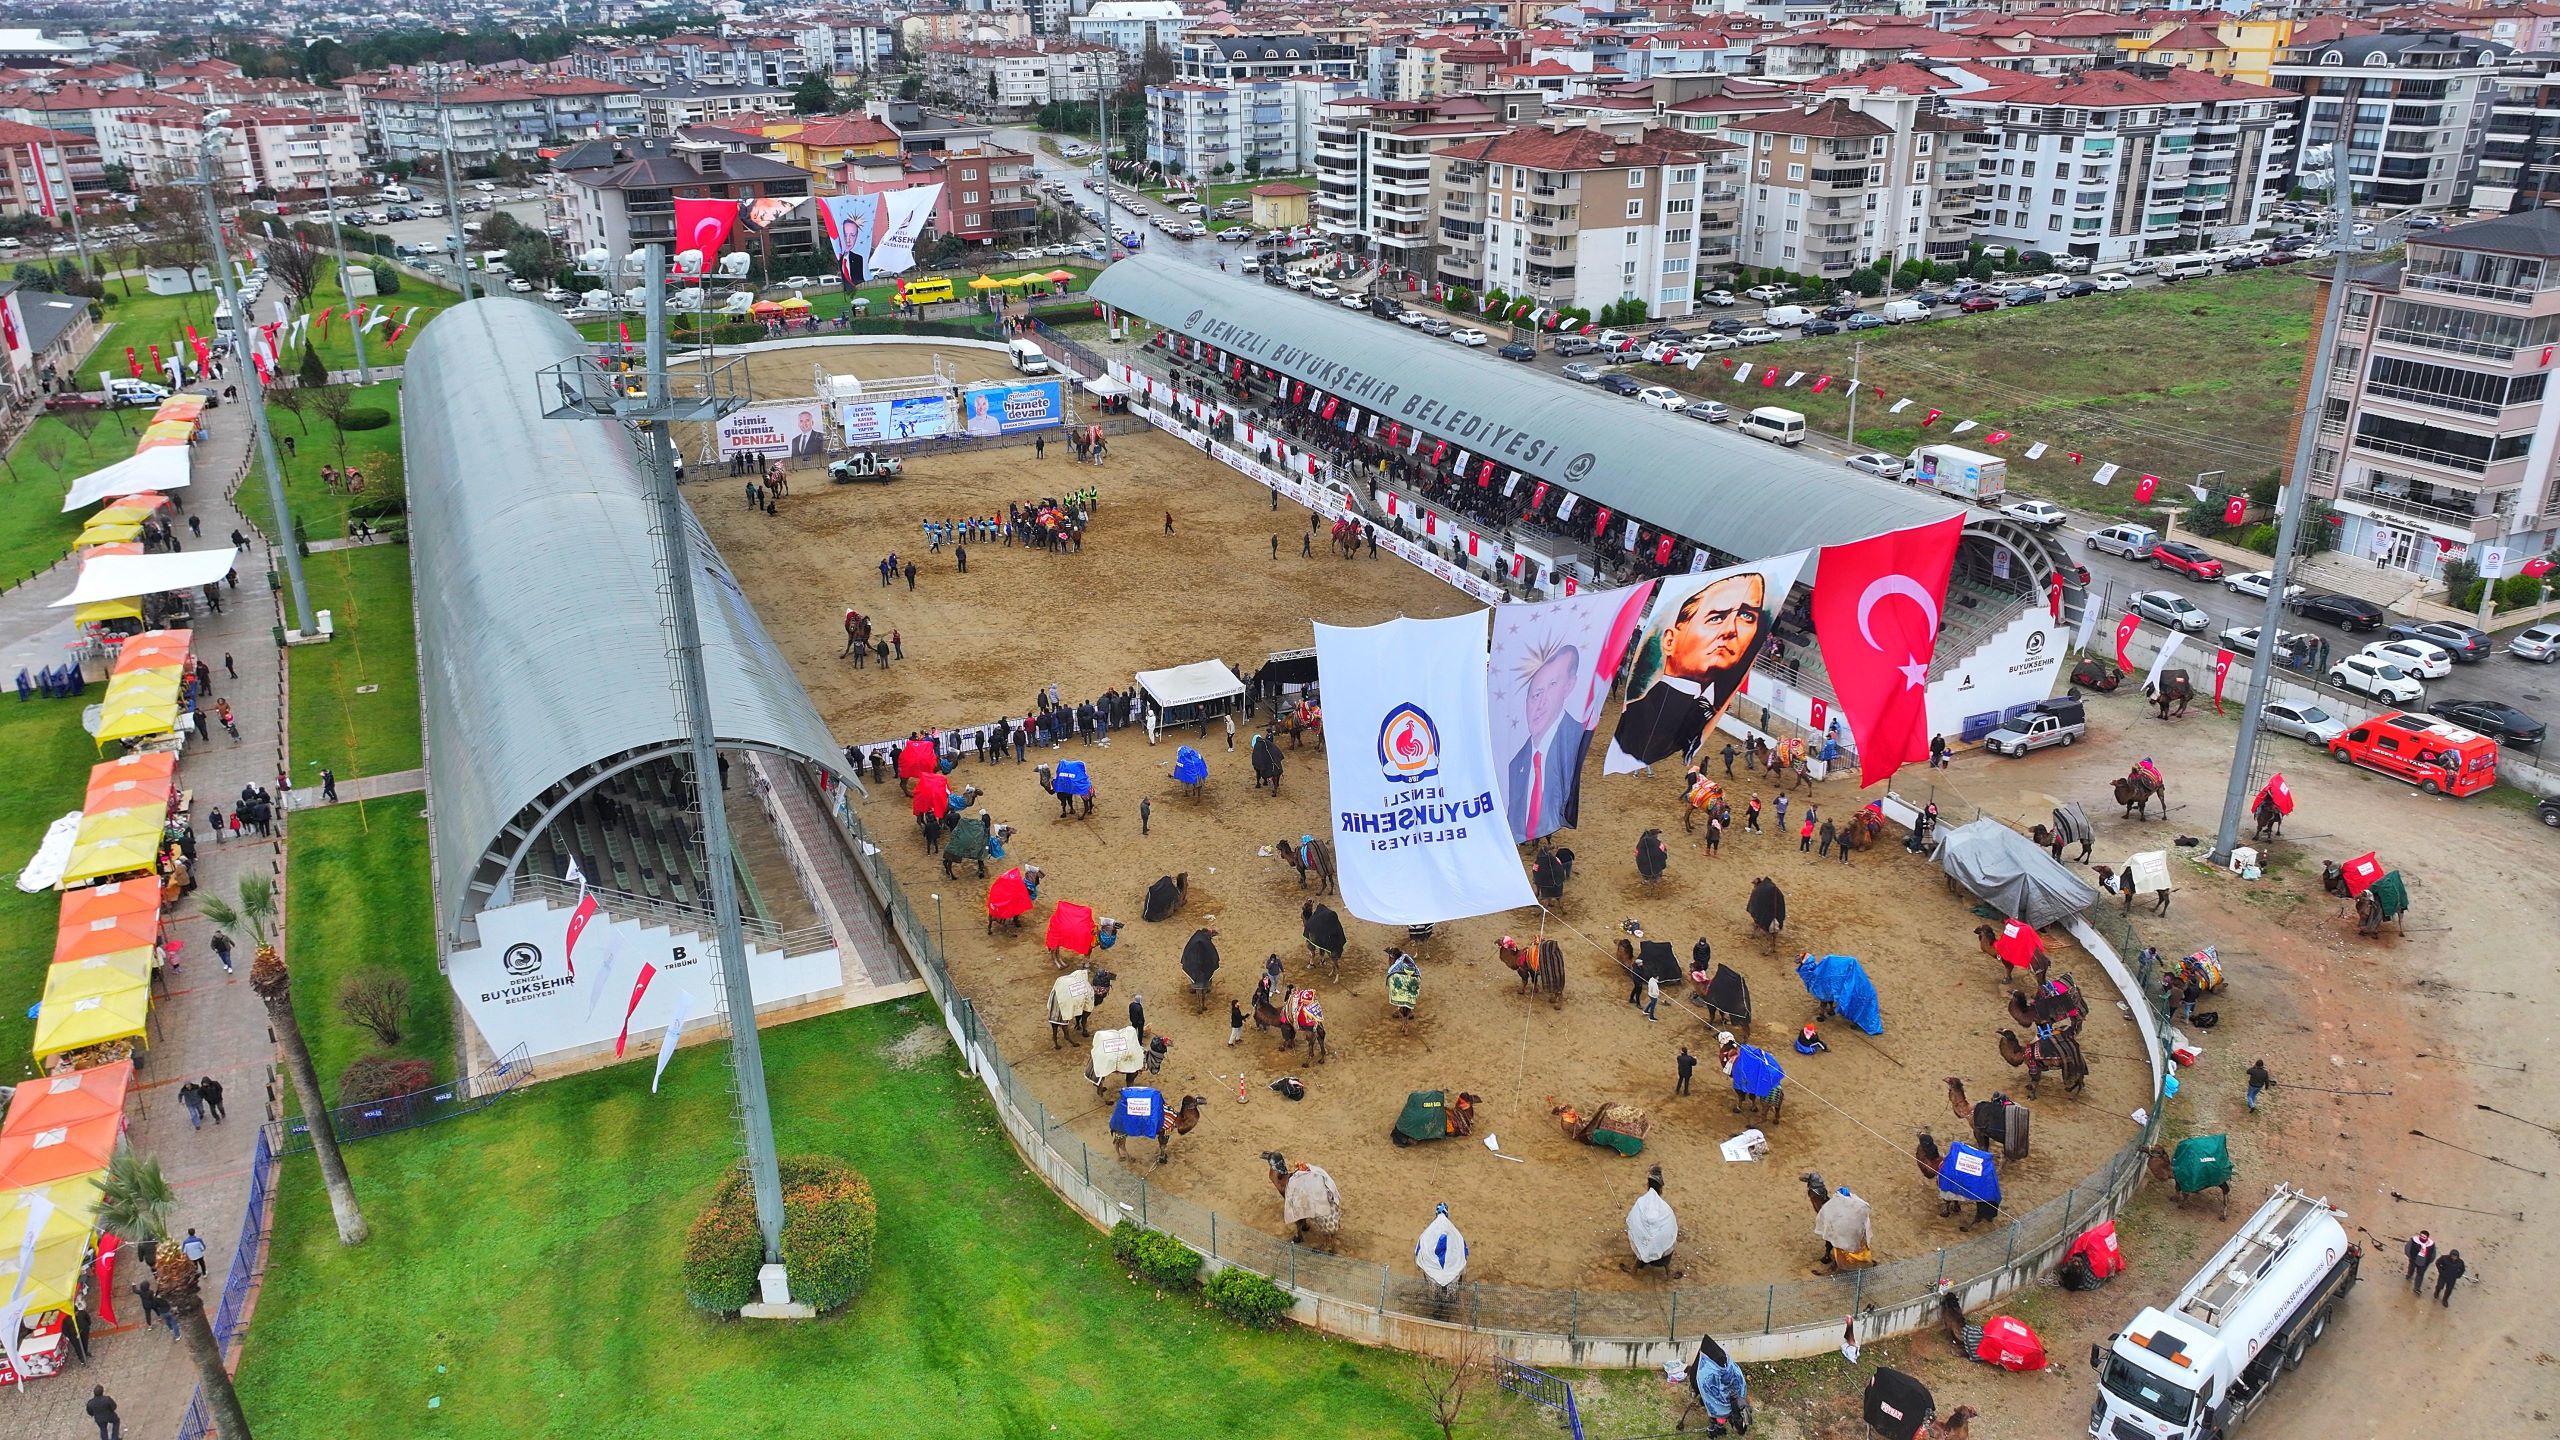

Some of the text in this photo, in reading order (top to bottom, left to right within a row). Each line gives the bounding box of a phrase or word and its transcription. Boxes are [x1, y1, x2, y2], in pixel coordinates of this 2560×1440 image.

[1201, 318, 1559, 467] DENİZLİ BÜYÜKŞEHİR BELEDİYESİ
[1004, 399, 1049, 410] hizmete
[1009, 409, 1045, 418] devam
[734, 415, 766, 427] işimiz
[724, 425, 774, 438] gücümüz
[732, 434, 785, 446] DENİZLİ
[1963, 675, 1971, 685] A
[672, 946, 686, 961] B
